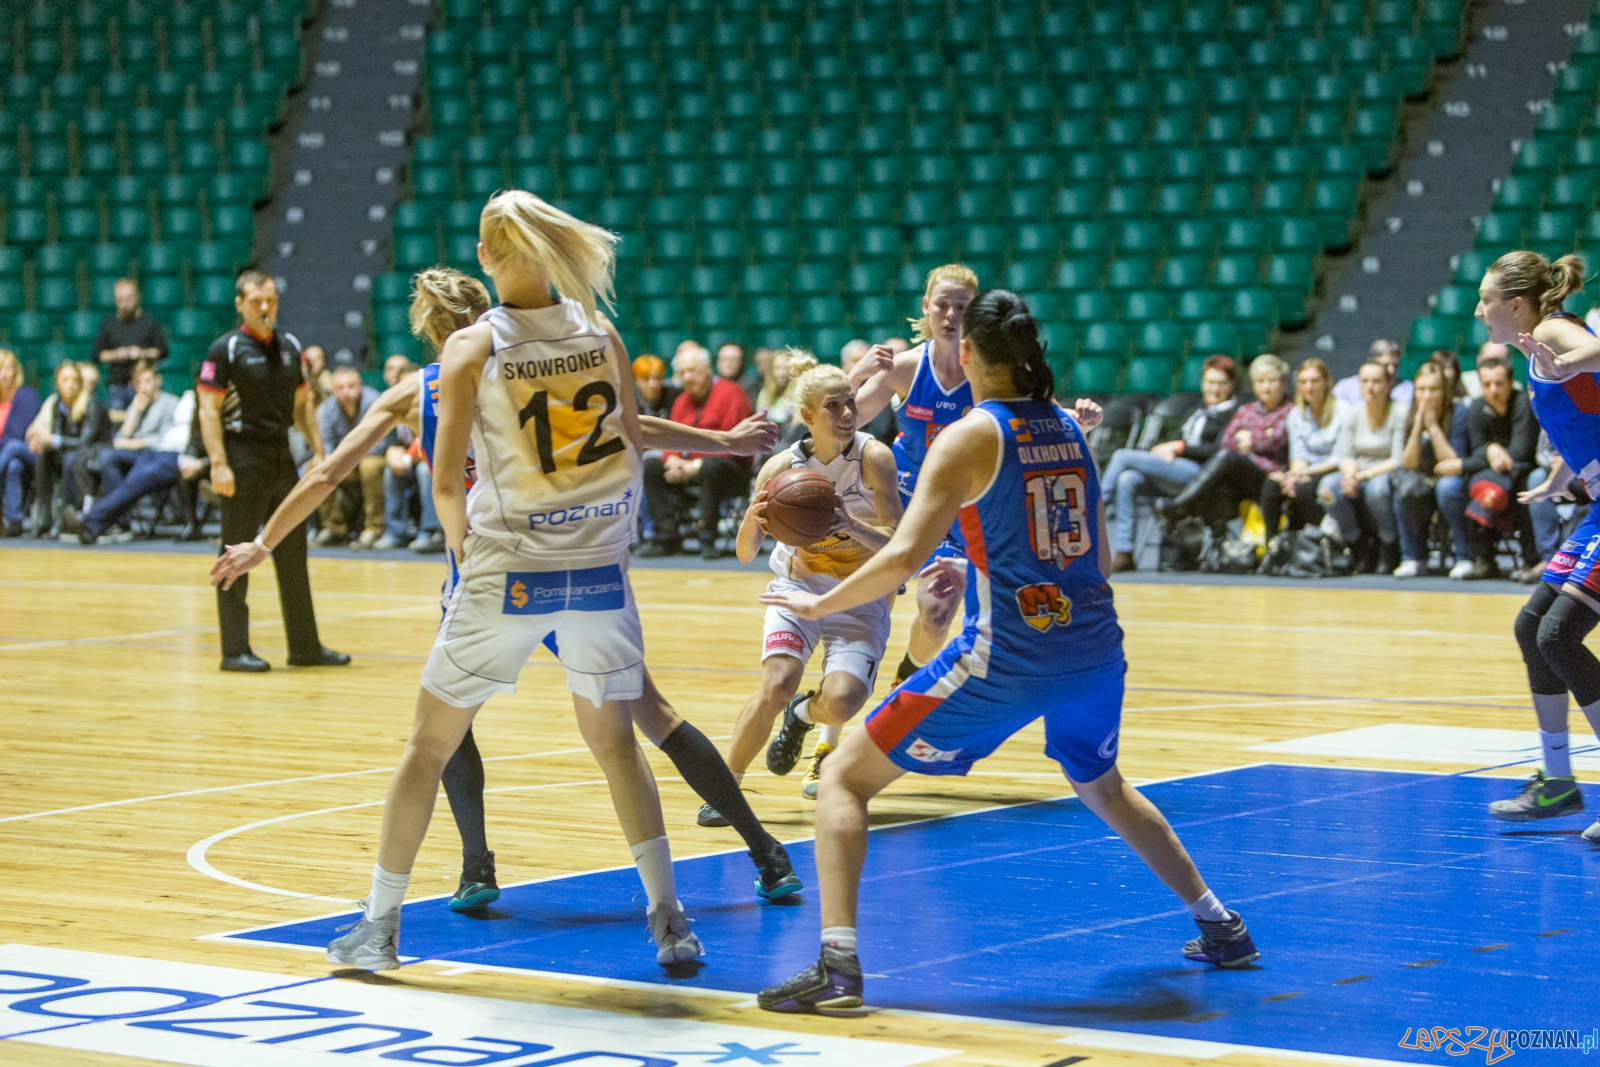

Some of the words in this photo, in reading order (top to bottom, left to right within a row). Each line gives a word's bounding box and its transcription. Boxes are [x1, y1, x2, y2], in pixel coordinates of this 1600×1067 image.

[503, 345, 607, 381] SKOWRONEK
[907, 404, 934, 417] TAURON
[518, 379, 626, 476] 12
[1017, 441, 1085, 465] OLKHOVIK
[1025, 471, 1092, 562] 13
[866, 659, 876, 679] 7
